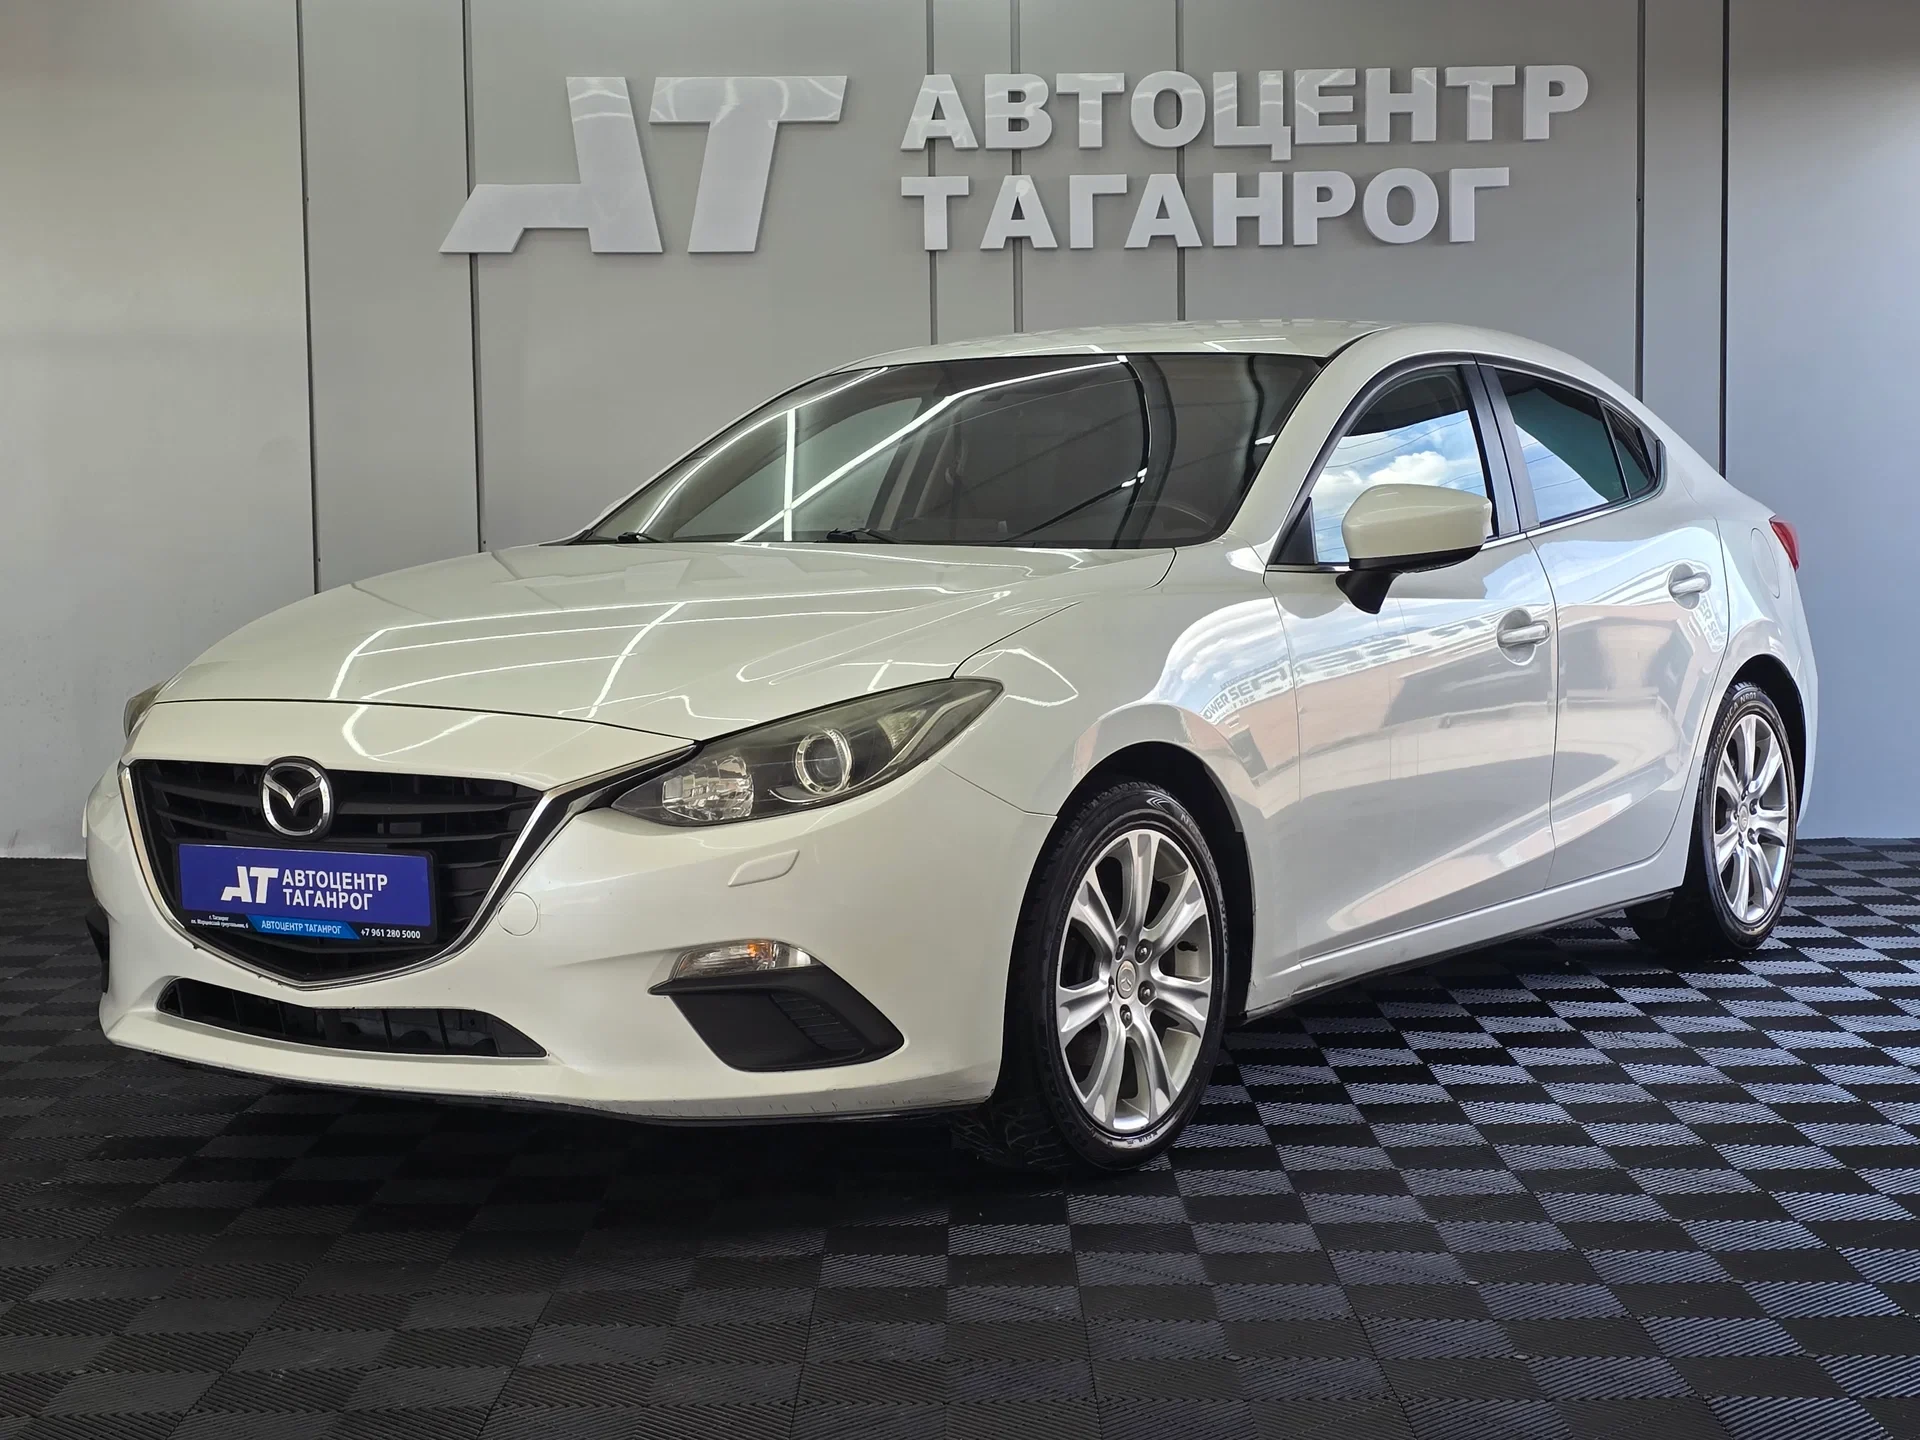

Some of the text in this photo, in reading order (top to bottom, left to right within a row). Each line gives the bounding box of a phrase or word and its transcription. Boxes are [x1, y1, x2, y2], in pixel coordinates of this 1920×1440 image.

[901, 65, 1589, 162] АВТОЦЕНТР
[901, 167, 1510, 250] ТАГАНРОГ
[282, 869, 388, 892] АВТОЦЕНТР
[283, 889, 373, 911] ТАГАНРОГ
[261, 920, 342, 935] АВТОЦЕНТР ТАГАНРОГ
[360, 928, 421, 939] +7 961 280 5000
